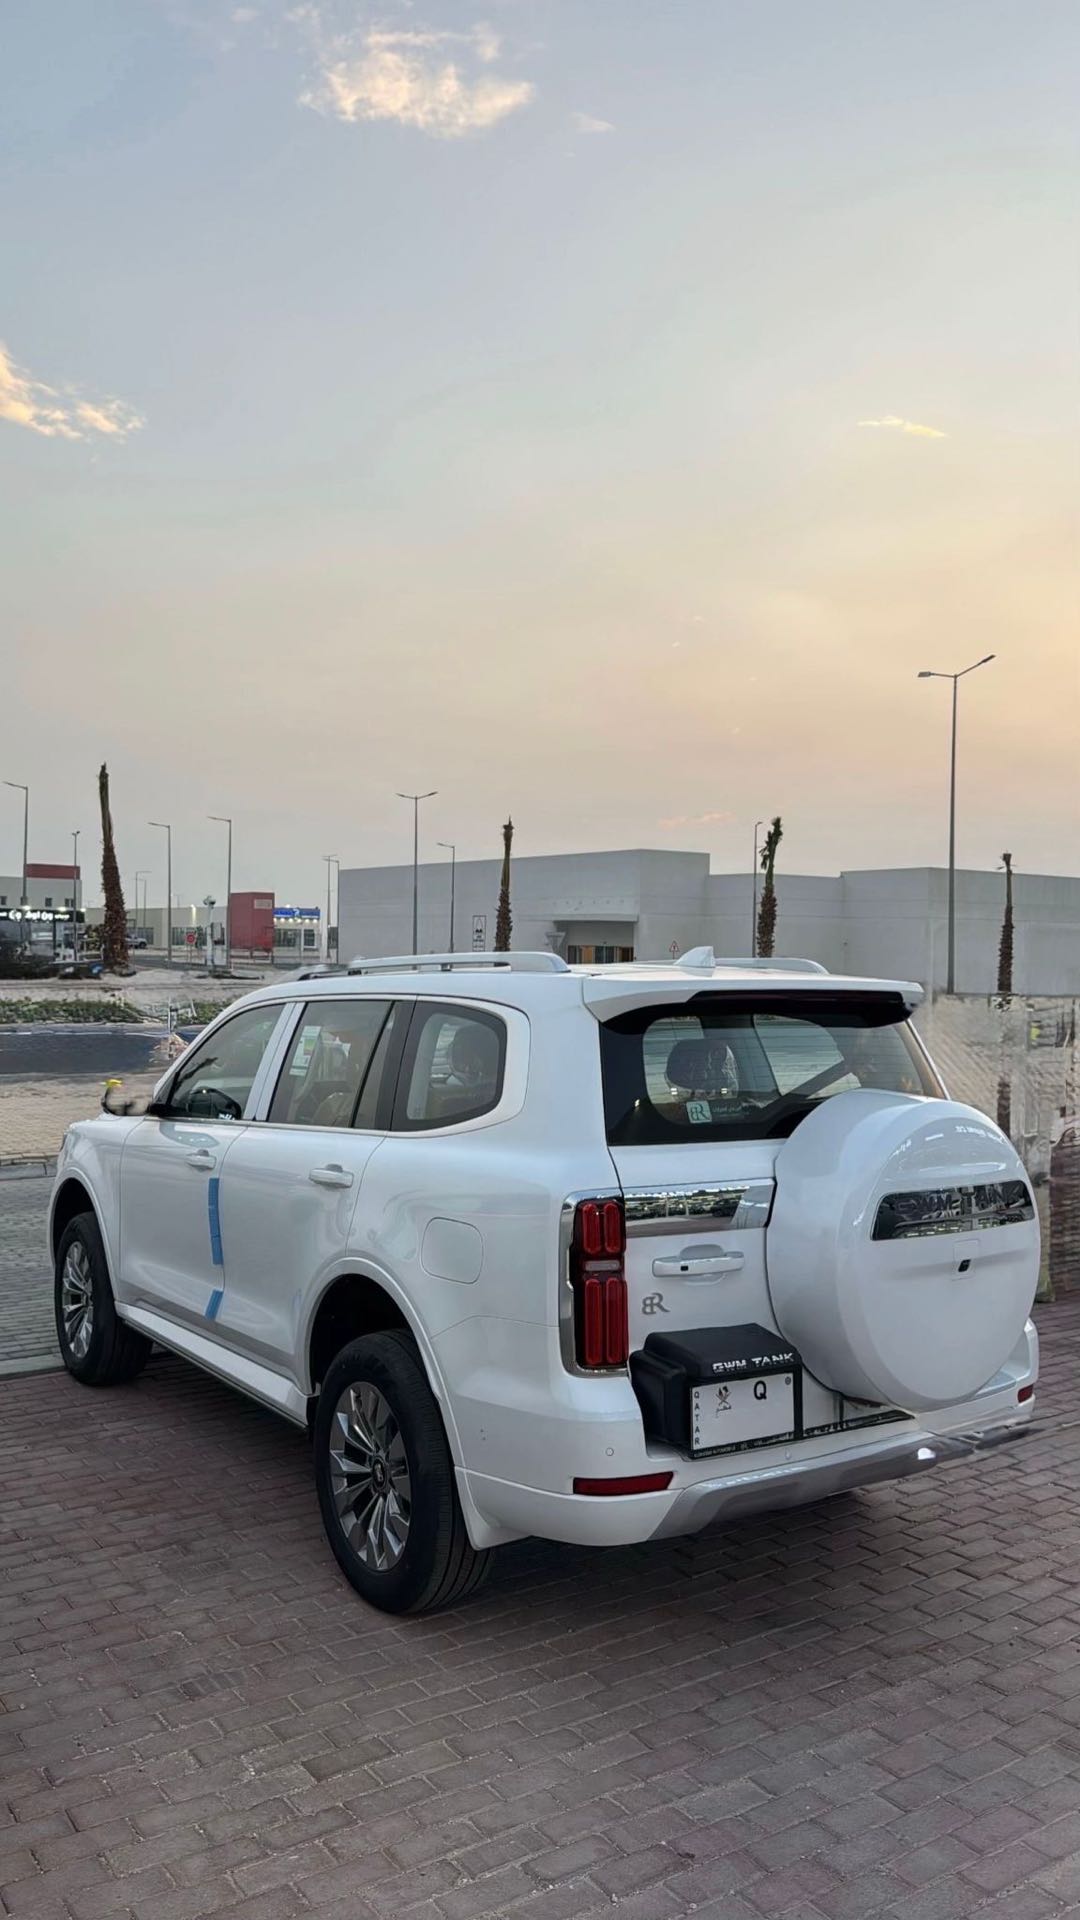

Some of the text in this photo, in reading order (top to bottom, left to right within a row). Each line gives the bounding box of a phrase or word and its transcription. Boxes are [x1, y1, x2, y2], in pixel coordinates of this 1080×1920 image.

[712, 1353, 794, 1373] GWM TANK
[754, 1380, 767, 1400] Q
[693, 1391, 701, 1446] QATAR
